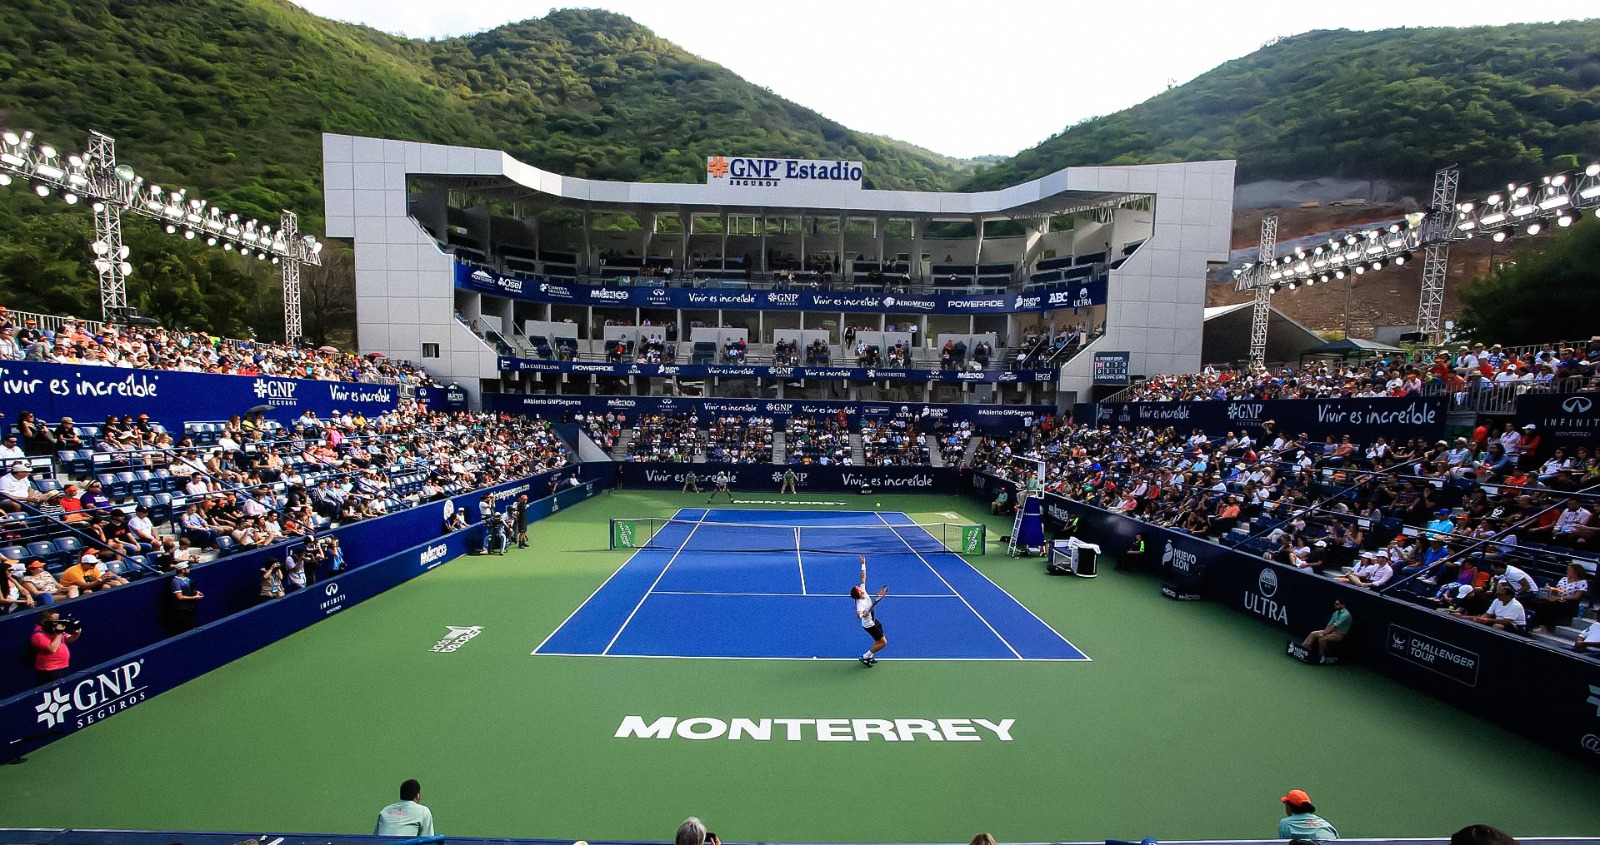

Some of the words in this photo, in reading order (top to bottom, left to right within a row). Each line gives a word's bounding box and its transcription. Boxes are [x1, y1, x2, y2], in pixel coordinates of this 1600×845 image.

[730, 158, 778, 178] GNP
[785, 160, 862, 181] Estadio
[729, 179, 778, 187] SEGUROS
[504, 278, 523, 290] Osel
[688, 292, 707, 303] Vivir
[709, 295, 718, 303] es
[777, 293, 798, 302] GNP
[813, 295, 832, 306] Vivir
[833, 298, 842, 306] es
[947, 300, 1005, 308] POWERADE
[1048, 291, 1069, 304] ABC
[707, 366, 721, 375] Vivir
[805, 368, 819, 376] Vivir
[1035, 372, 1051, 381] terza
[0, 367, 43, 395] ivir
[49, 378, 70, 396] es
[76, 373, 158, 398] increíble
[267, 380, 296, 398] GNP
[330, 384, 350, 401] Vivir
[351, 391, 359, 402] es
[704, 402, 720, 411] Vivir
[770, 403, 793, 411] GNP
[801, 405, 818, 414] Vivir
[1139, 405, 1152, 419] Vivir
[1153, 410, 1160, 419] es
[1237, 403, 1263, 419] GNP
[1318, 404, 1347, 423] Vivir
[1350, 411, 1362, 425] es
[1366, 402, 1436, 425] increíble
[1544, 418, 1600, 427] INFINIT
[645, 469, 672, 482] Vivir
[674, 474, 684, 482] es
[871, 478, 881, 486] es
[884, 474, 933, 487] increíble
[1173, 548, 1197, 565] NUEVO
[320, 593, 346, 610] INFINITI
[1244, 591, 1288, 625] ULTRA
[1411, 639, 1475, 669] CHALLENGER
[1411, 647, 1435, 663] TOUR
[73, 661, 141, 711] GNP
[77, 692, 146, 729] SEGUROS
[614, 715, 1016, 742] MONTERREY
